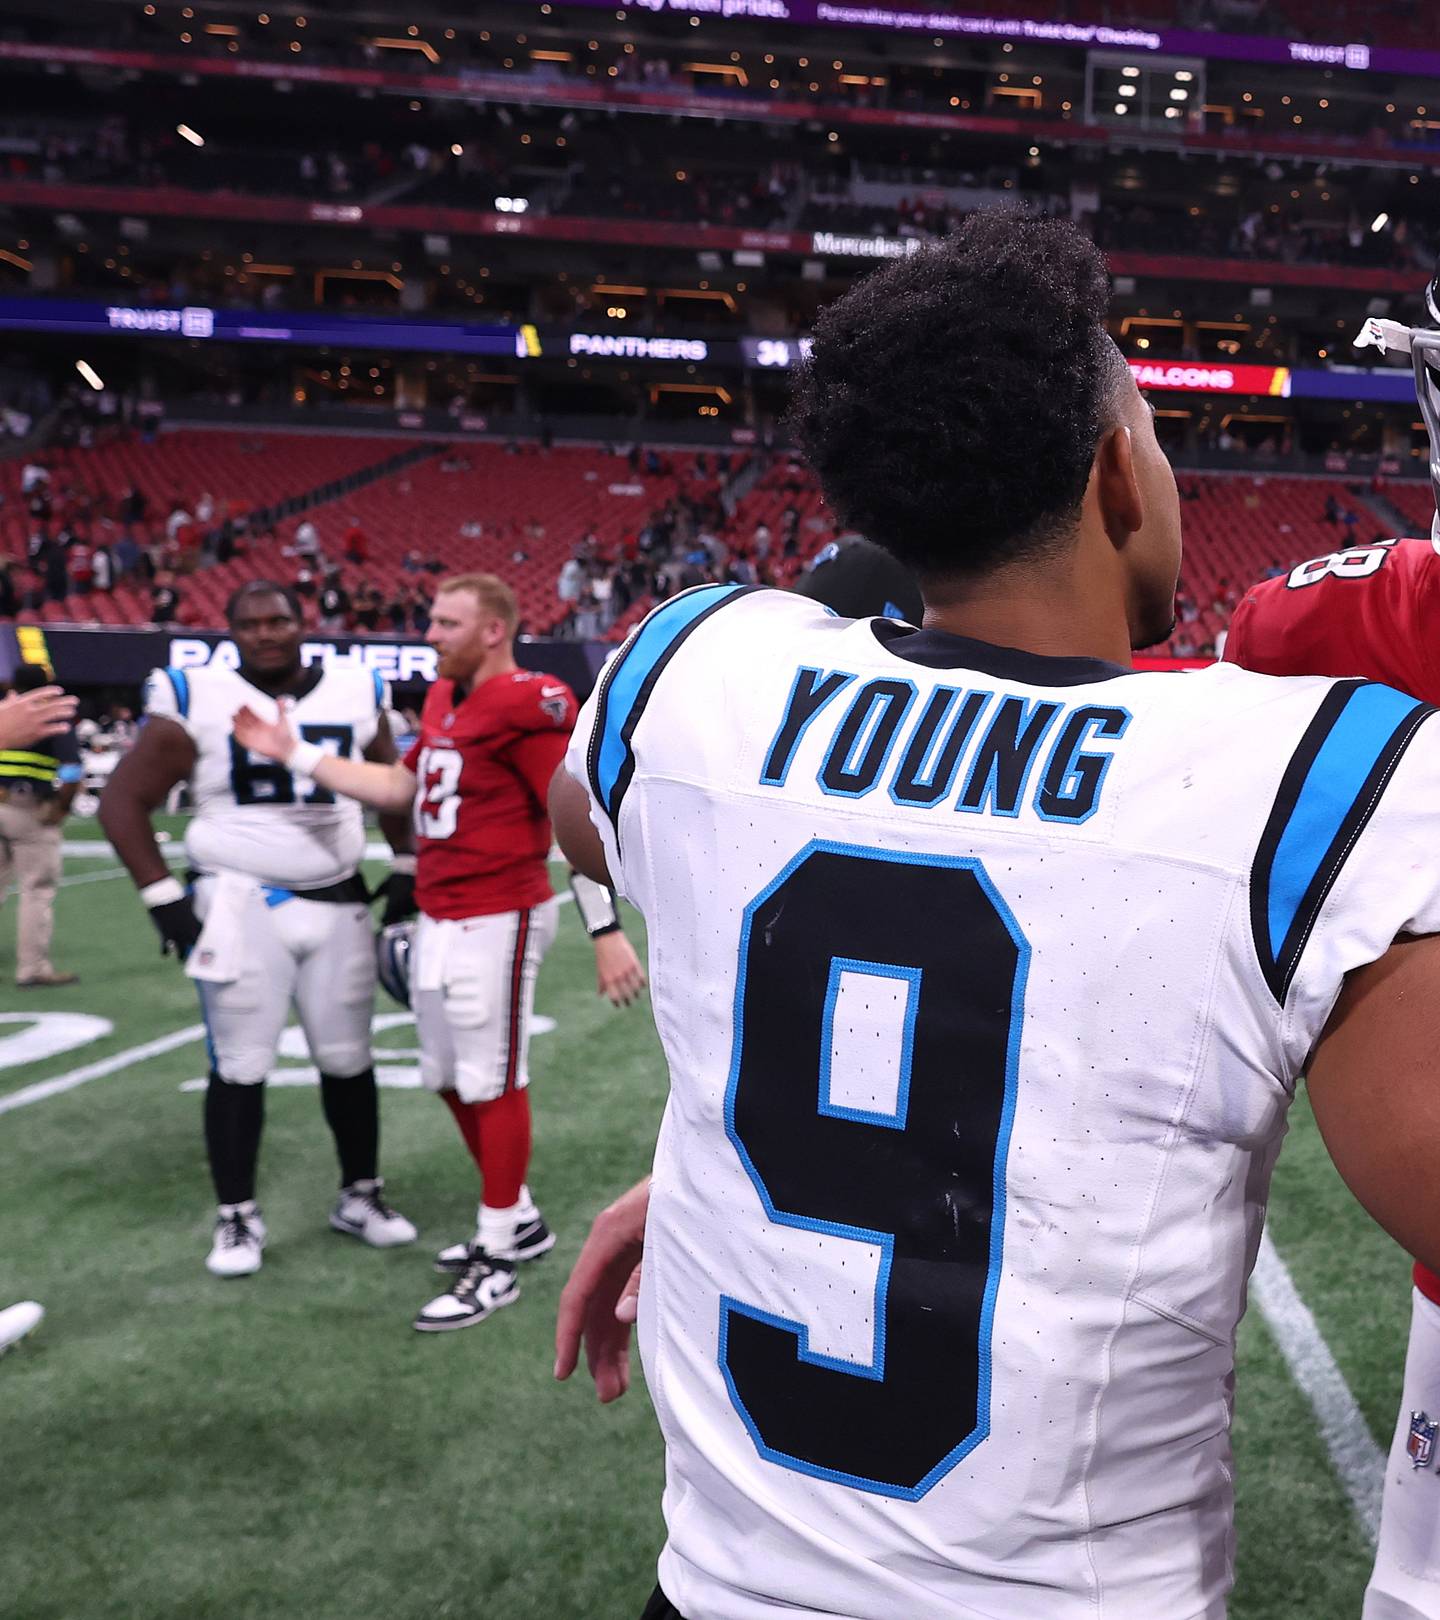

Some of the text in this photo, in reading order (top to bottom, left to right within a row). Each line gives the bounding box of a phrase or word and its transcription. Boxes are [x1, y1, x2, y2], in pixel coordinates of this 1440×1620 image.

[813, 231, 921, 258] Mercedes-B
[106, 306, 181, 331] TRUIST
[570, 333, 708, 360] PANTHERS
[1285, 537, 1399, 590] 8
[759, 665, 1134, 825] YOUNG
[414, 746, 464, 840] 13
[719, 838, 1032, 1502] 9
